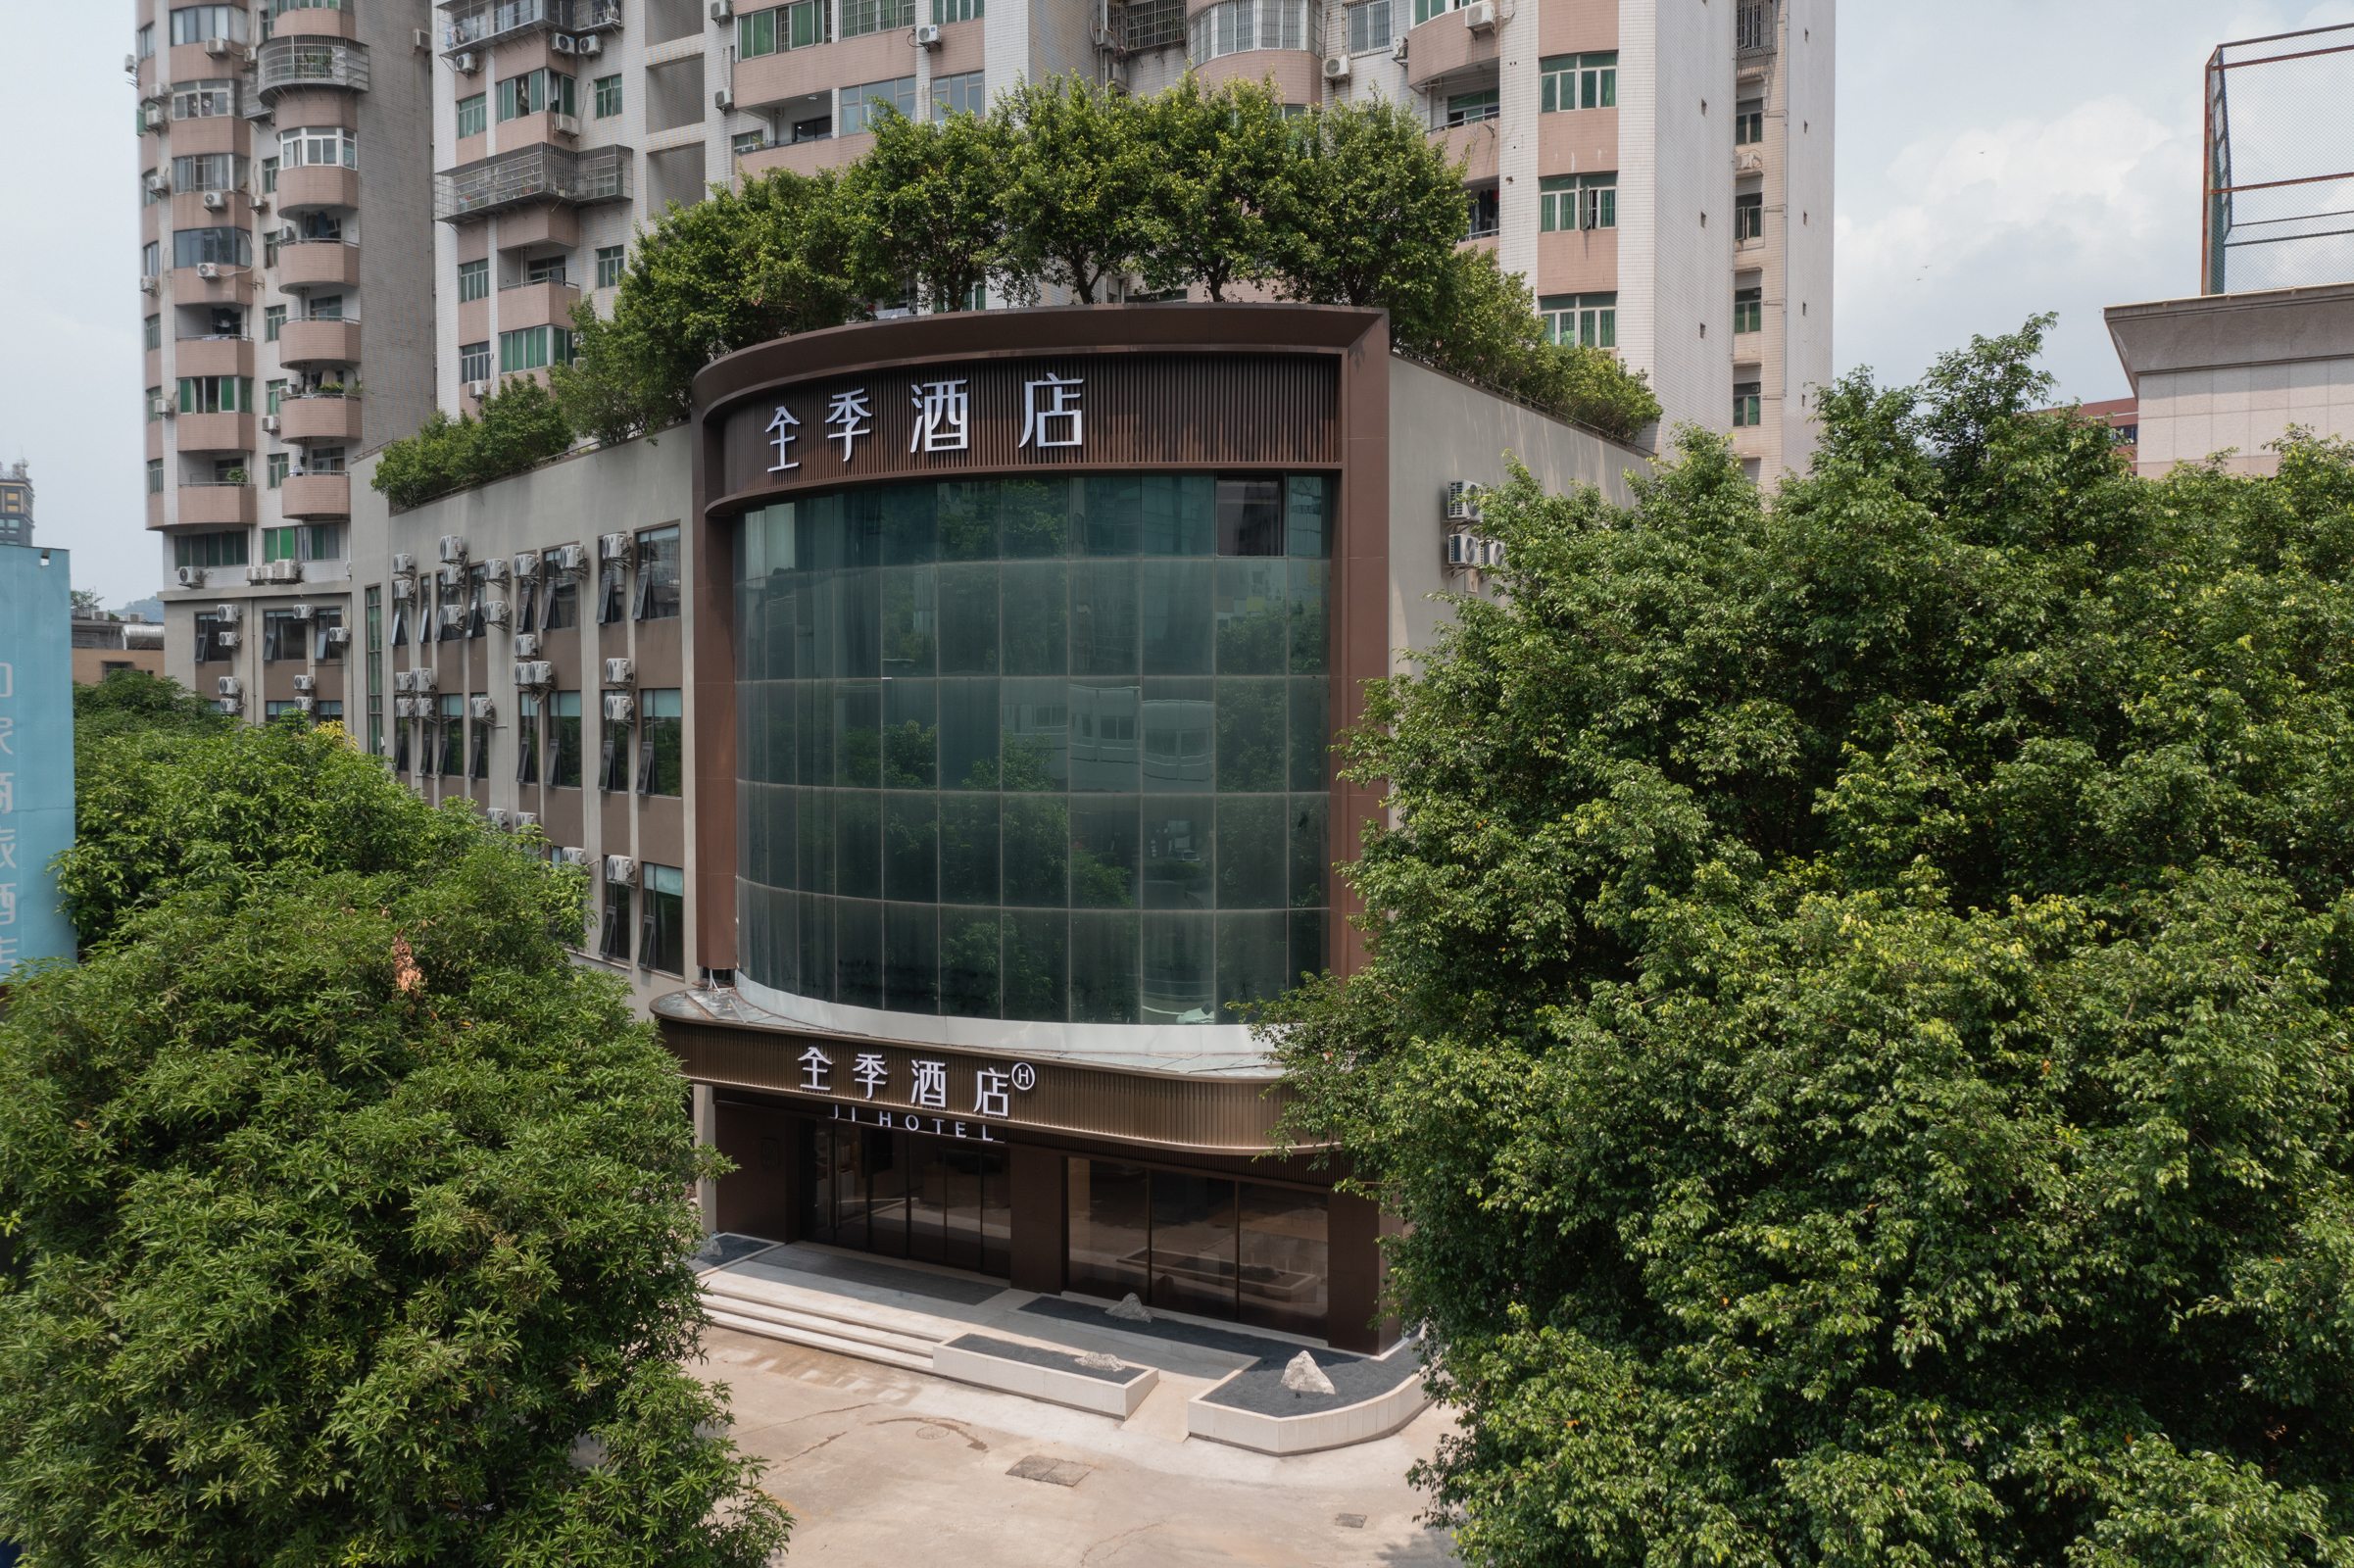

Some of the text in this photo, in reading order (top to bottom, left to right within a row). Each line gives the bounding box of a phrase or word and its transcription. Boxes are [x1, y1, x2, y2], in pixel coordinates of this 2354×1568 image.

[764, 372, 1085, 472] 全季酒店
[797, 1046, 1009, 1117] 全季酒店
[834, 1103, 994, 1142] JI HOTEL
